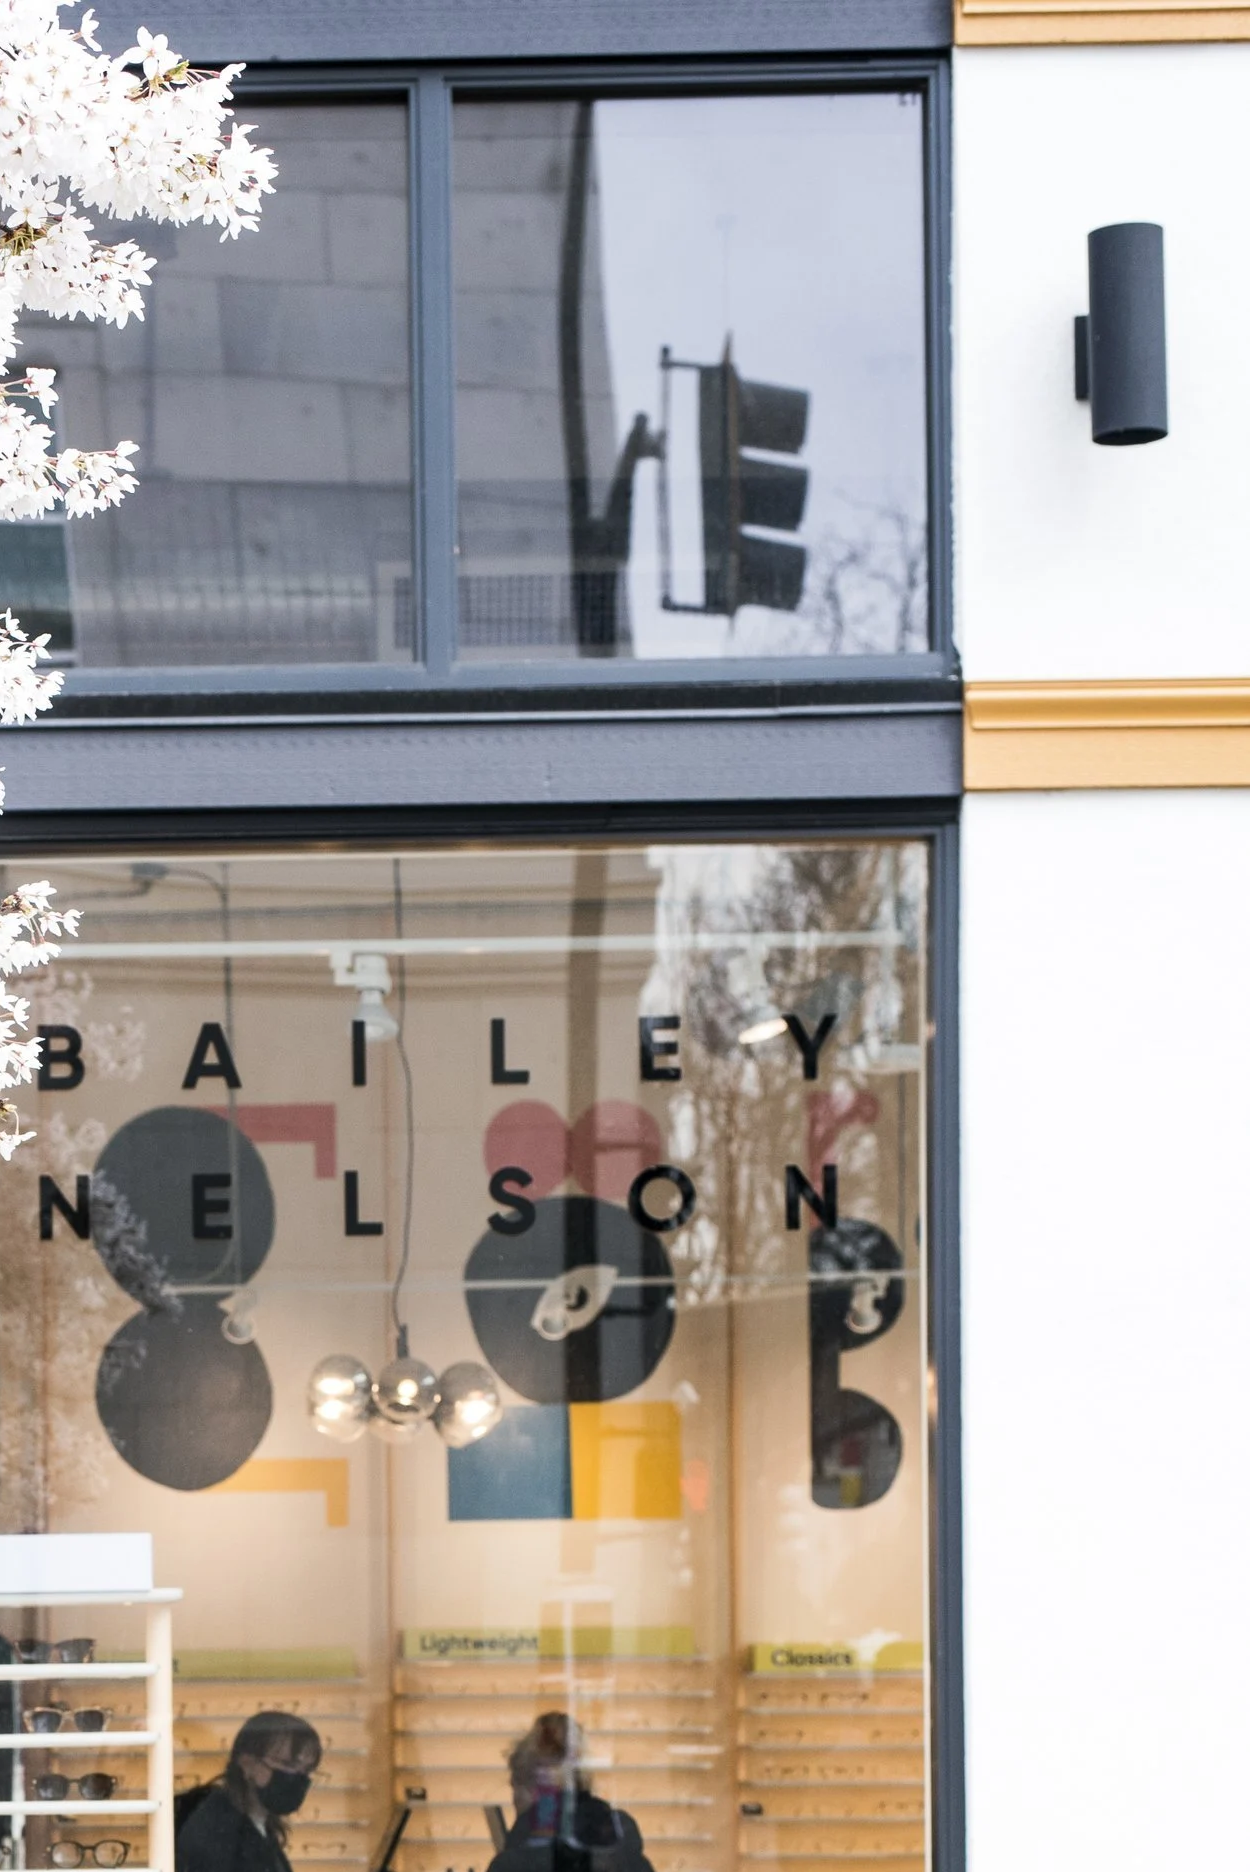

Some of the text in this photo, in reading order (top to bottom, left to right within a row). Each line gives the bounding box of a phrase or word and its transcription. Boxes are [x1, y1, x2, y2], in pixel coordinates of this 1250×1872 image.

[37, 1014, 837, 1091] BAILEY
[39, 1163, 838, 1240] NELSON
[419, 1633, 538, 1656] Lightweight
[771, 1647, 853, 1667] Classics
